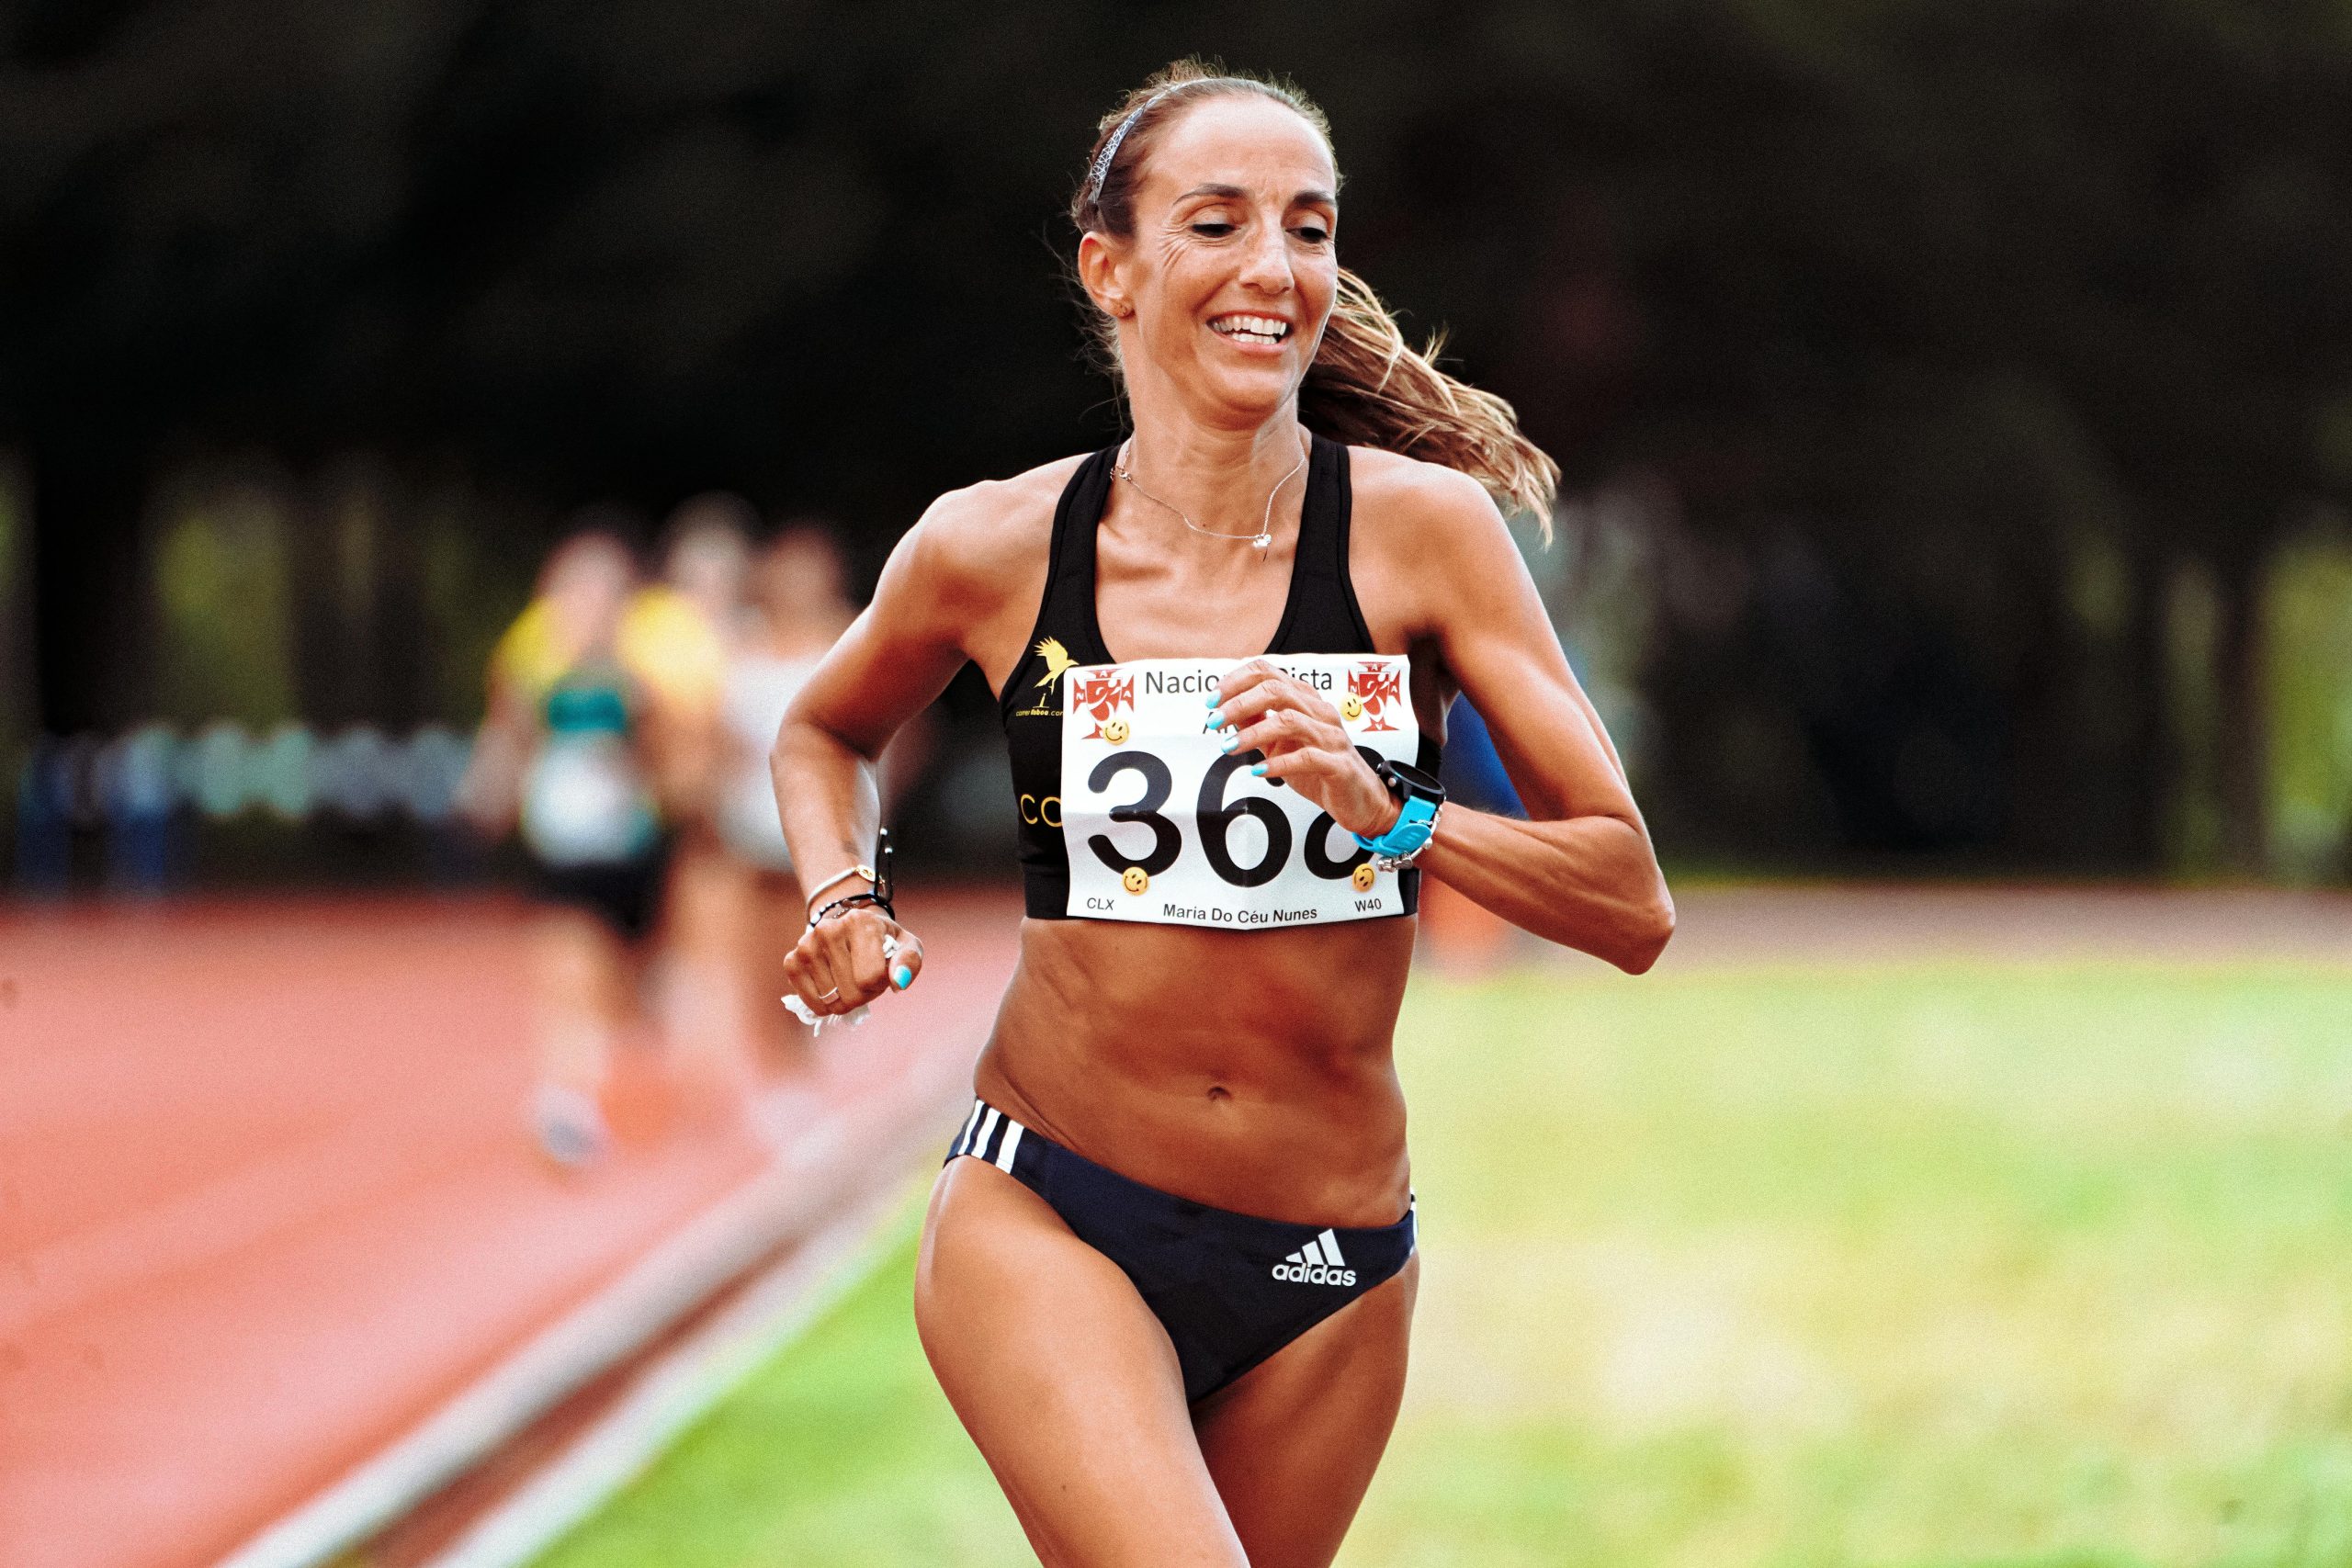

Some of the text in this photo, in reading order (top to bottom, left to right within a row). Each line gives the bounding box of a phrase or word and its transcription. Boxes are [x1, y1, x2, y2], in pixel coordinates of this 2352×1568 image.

[1146, 667, 1331, 694] Nacio ista
[1086, 897, 1114, 911] CLX
[1163, 903, 1317, 924] Maria Do Céu Nunes
[1354, 897, 1382, 913] W40
[1272, 1262, 1357, 1287] adidas
